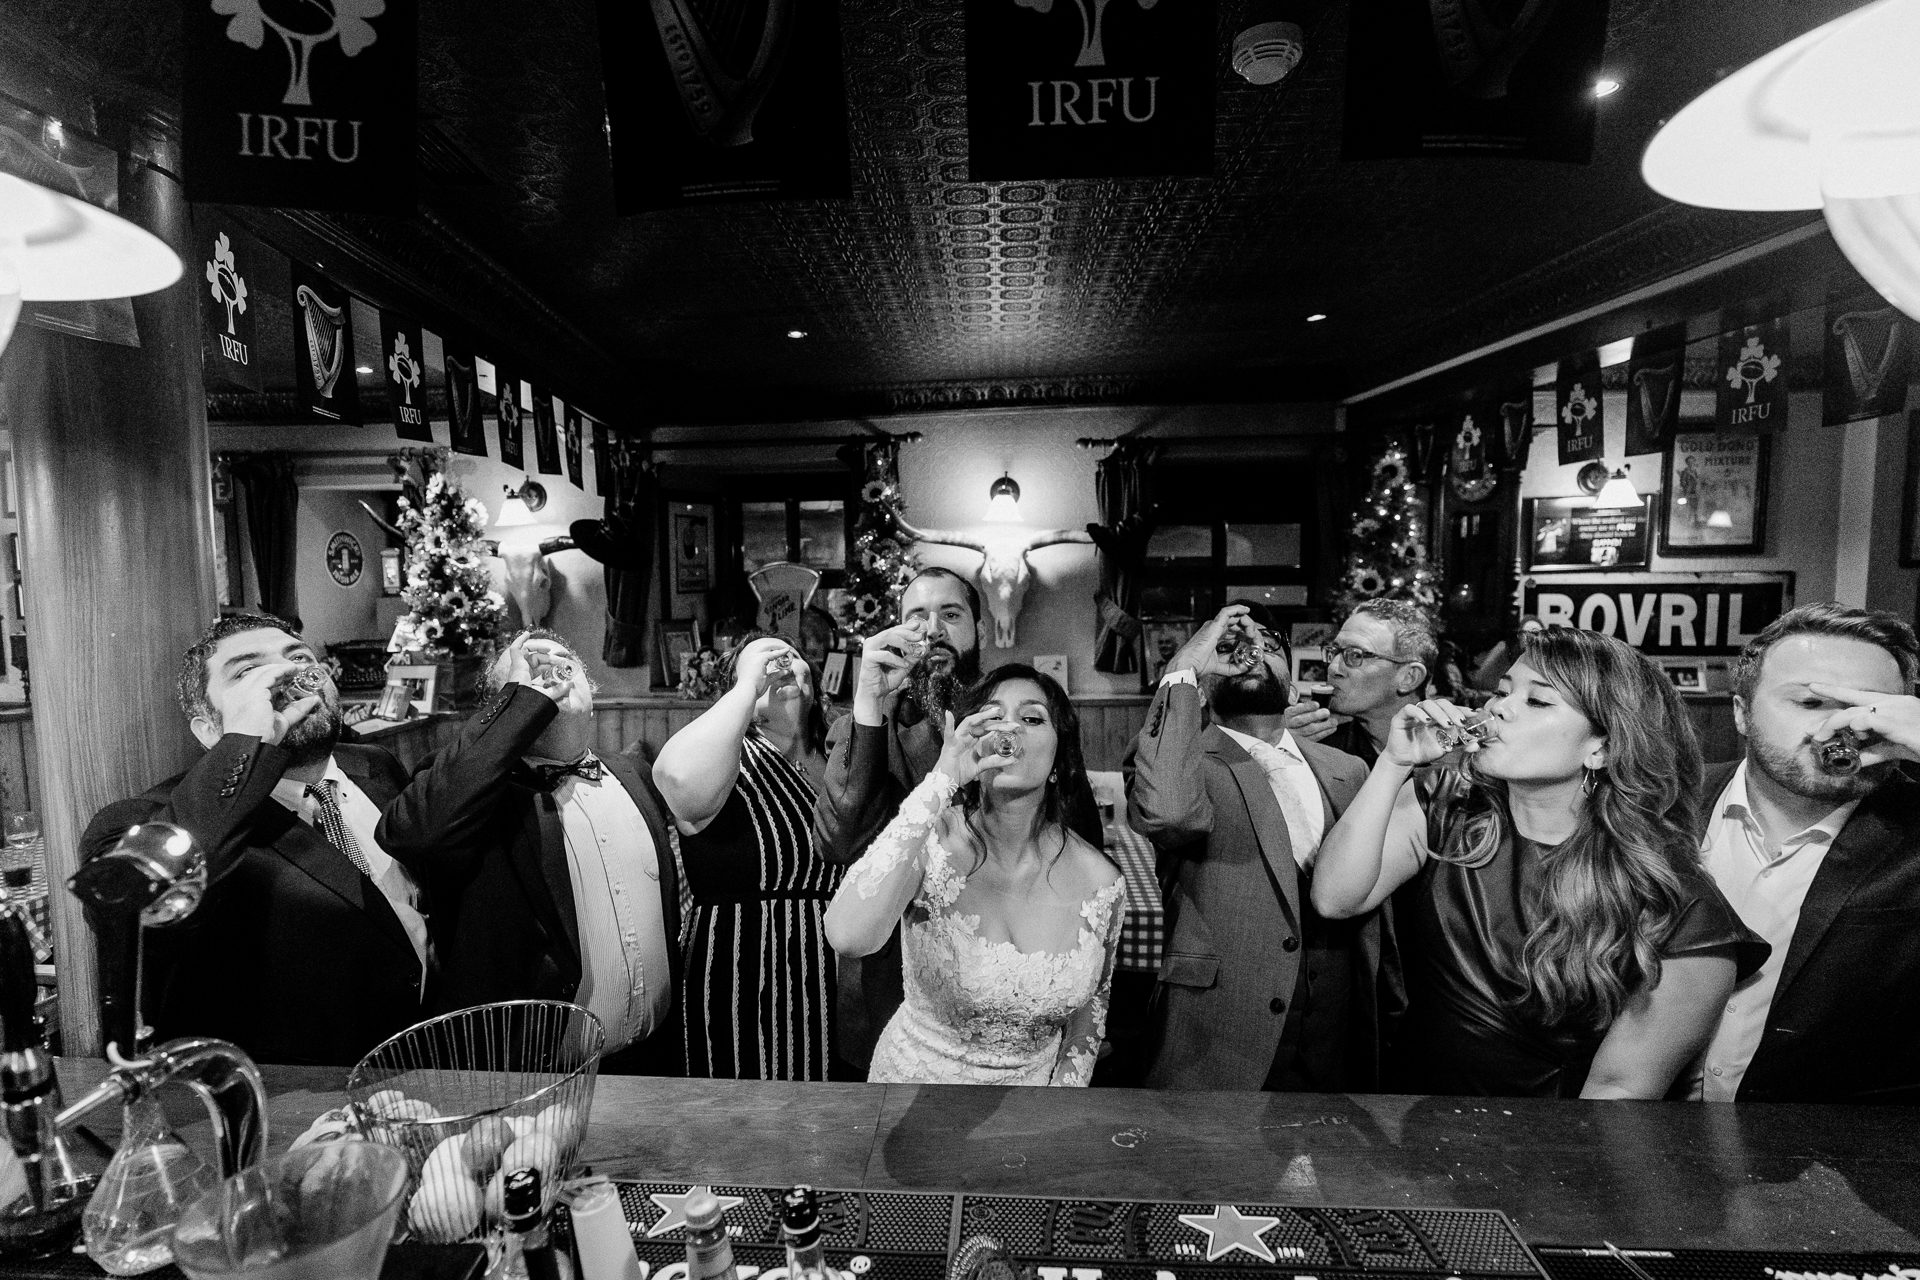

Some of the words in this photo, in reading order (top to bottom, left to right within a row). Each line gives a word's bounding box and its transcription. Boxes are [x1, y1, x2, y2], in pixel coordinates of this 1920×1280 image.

[680, 65, 712, 114] 1759
[1027, 76, 1161, 126] IRFU
[237, 112, 364, 163] IRFU
[219, 333, 248, 365] IRFU
[399, 405, 422, 425] IRFU
[1731, 402, 1771, 425] IRFU
[1566, 434, 1593, 453] IRFU
[1681, 441, 1714, 453] GOLD
[1704, 456, 1751, 467] MIXTURE
[778, 602, 797, 620] LIME
[1537, 593, 1761, 647] BOVRIL
